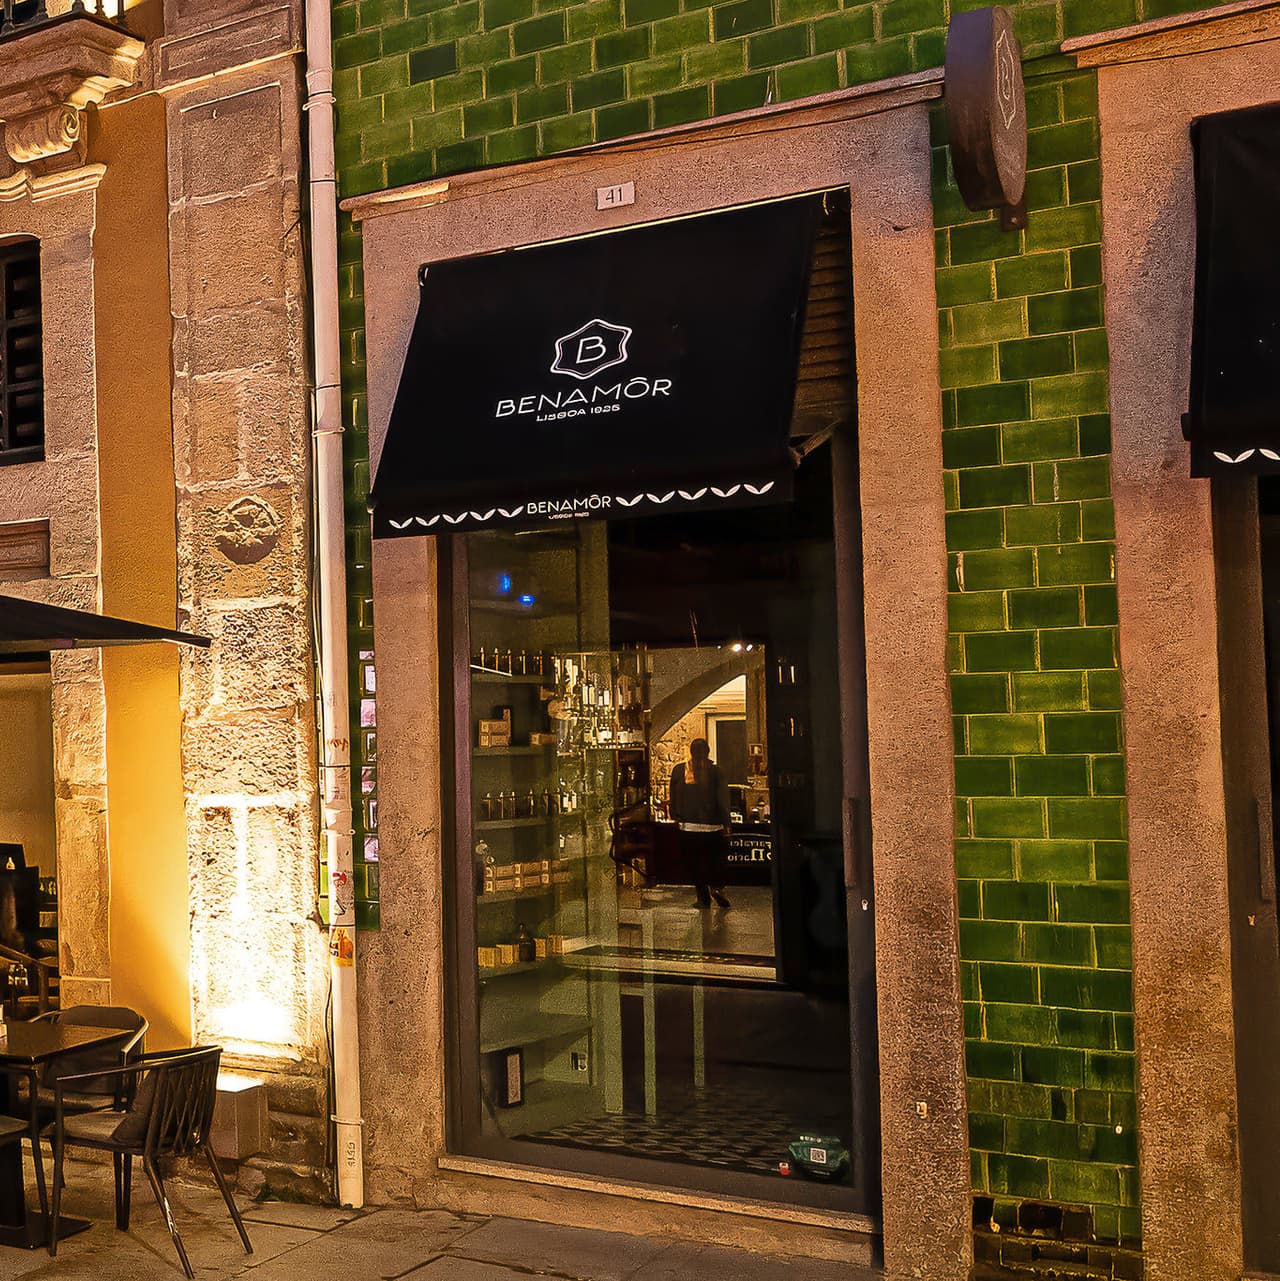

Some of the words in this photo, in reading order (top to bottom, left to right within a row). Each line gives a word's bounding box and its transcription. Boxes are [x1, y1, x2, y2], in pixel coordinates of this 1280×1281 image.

[605, 186, 623, 204] 41
[576, 335, 607, 364] B
[495, 376, 672, 418] BENAMÔR
[527, 494, 612, 515] BENAMÔR
